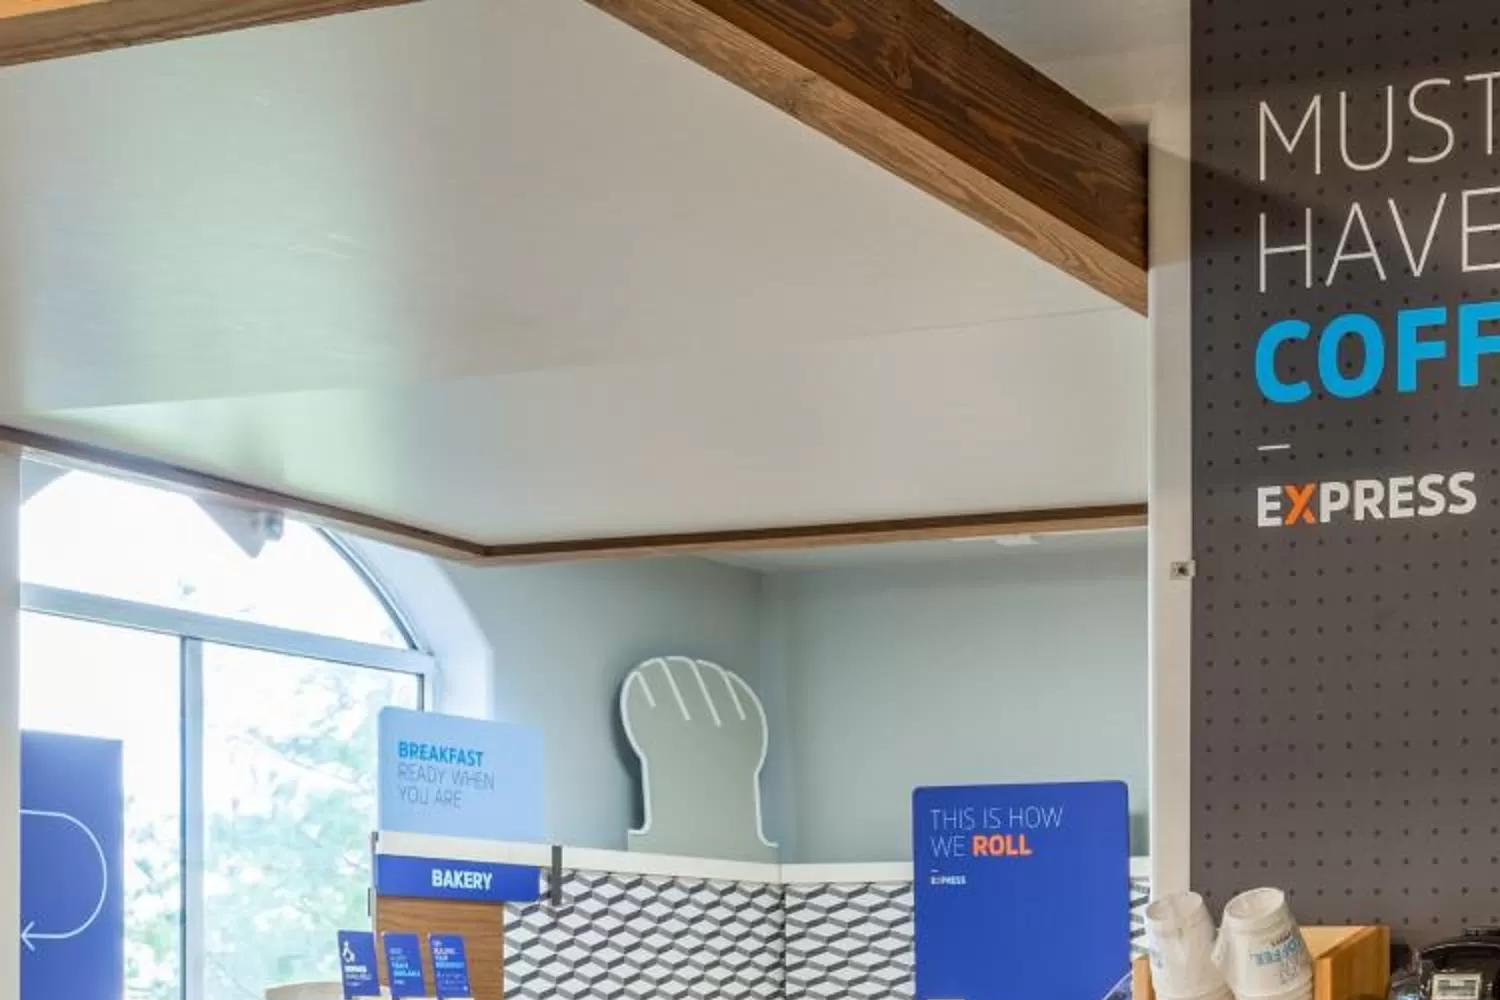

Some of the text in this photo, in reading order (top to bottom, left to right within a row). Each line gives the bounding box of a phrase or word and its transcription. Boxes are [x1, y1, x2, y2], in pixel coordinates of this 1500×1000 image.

[1257, 472, 1477, 527] EXPRESS
[398, 742, 483, 767] BREAKFAST
[397, 763, 495, 791] READY WHEN
[399, 784, 462, 808] YOU ARE
[929, 805, 1064, 831] THIS IS HOW
[930, 833, 1033, 858] WE ROLL
[431, 869, 493, 890] BAKERY
